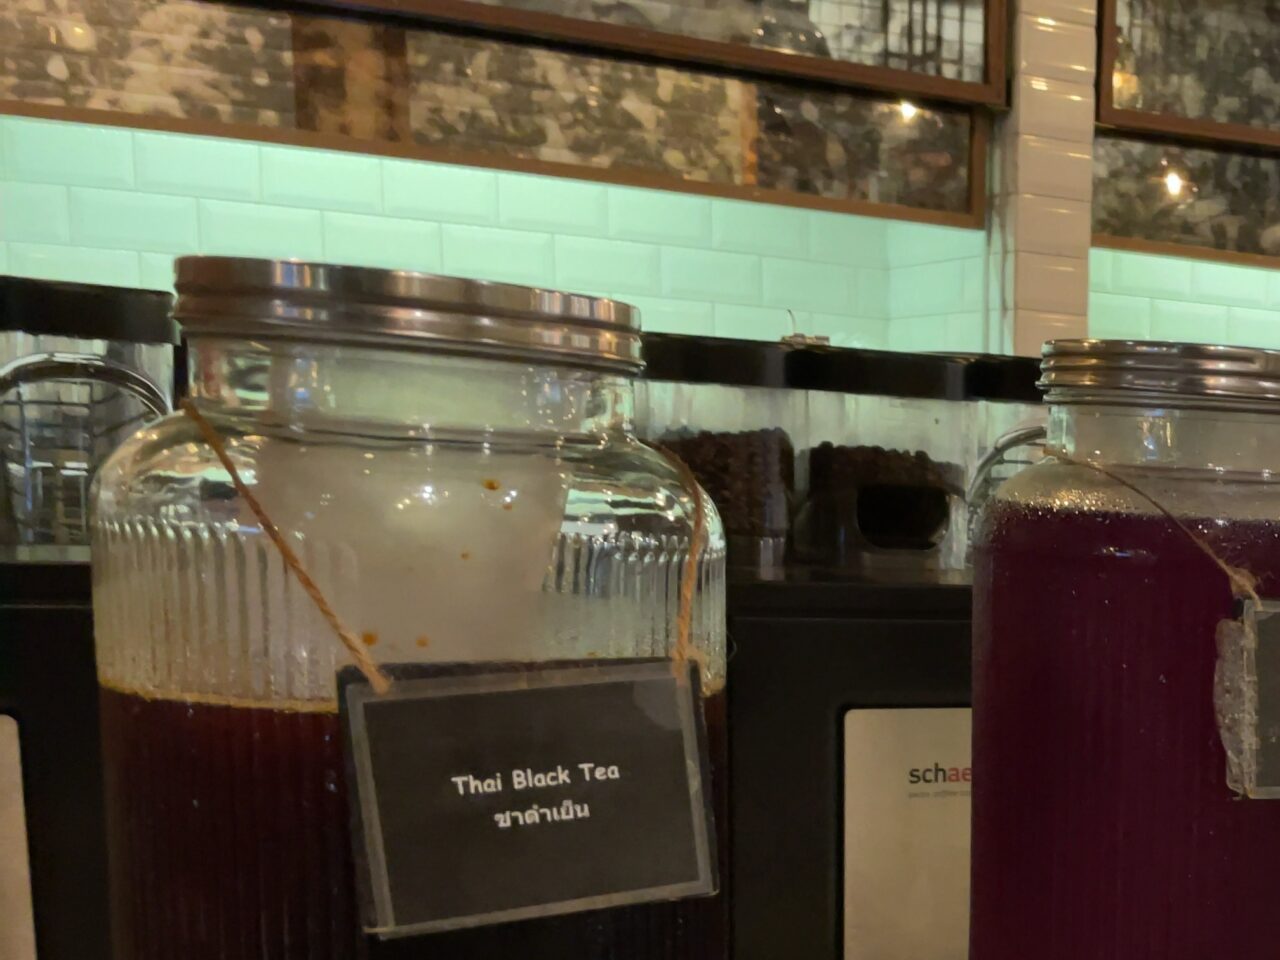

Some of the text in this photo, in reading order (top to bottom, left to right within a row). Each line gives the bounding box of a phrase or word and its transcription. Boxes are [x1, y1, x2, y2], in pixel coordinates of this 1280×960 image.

[451, 762, 620, 796] Thai Black Tea
[493, 799, 591, 828] ชาดำเย็น
